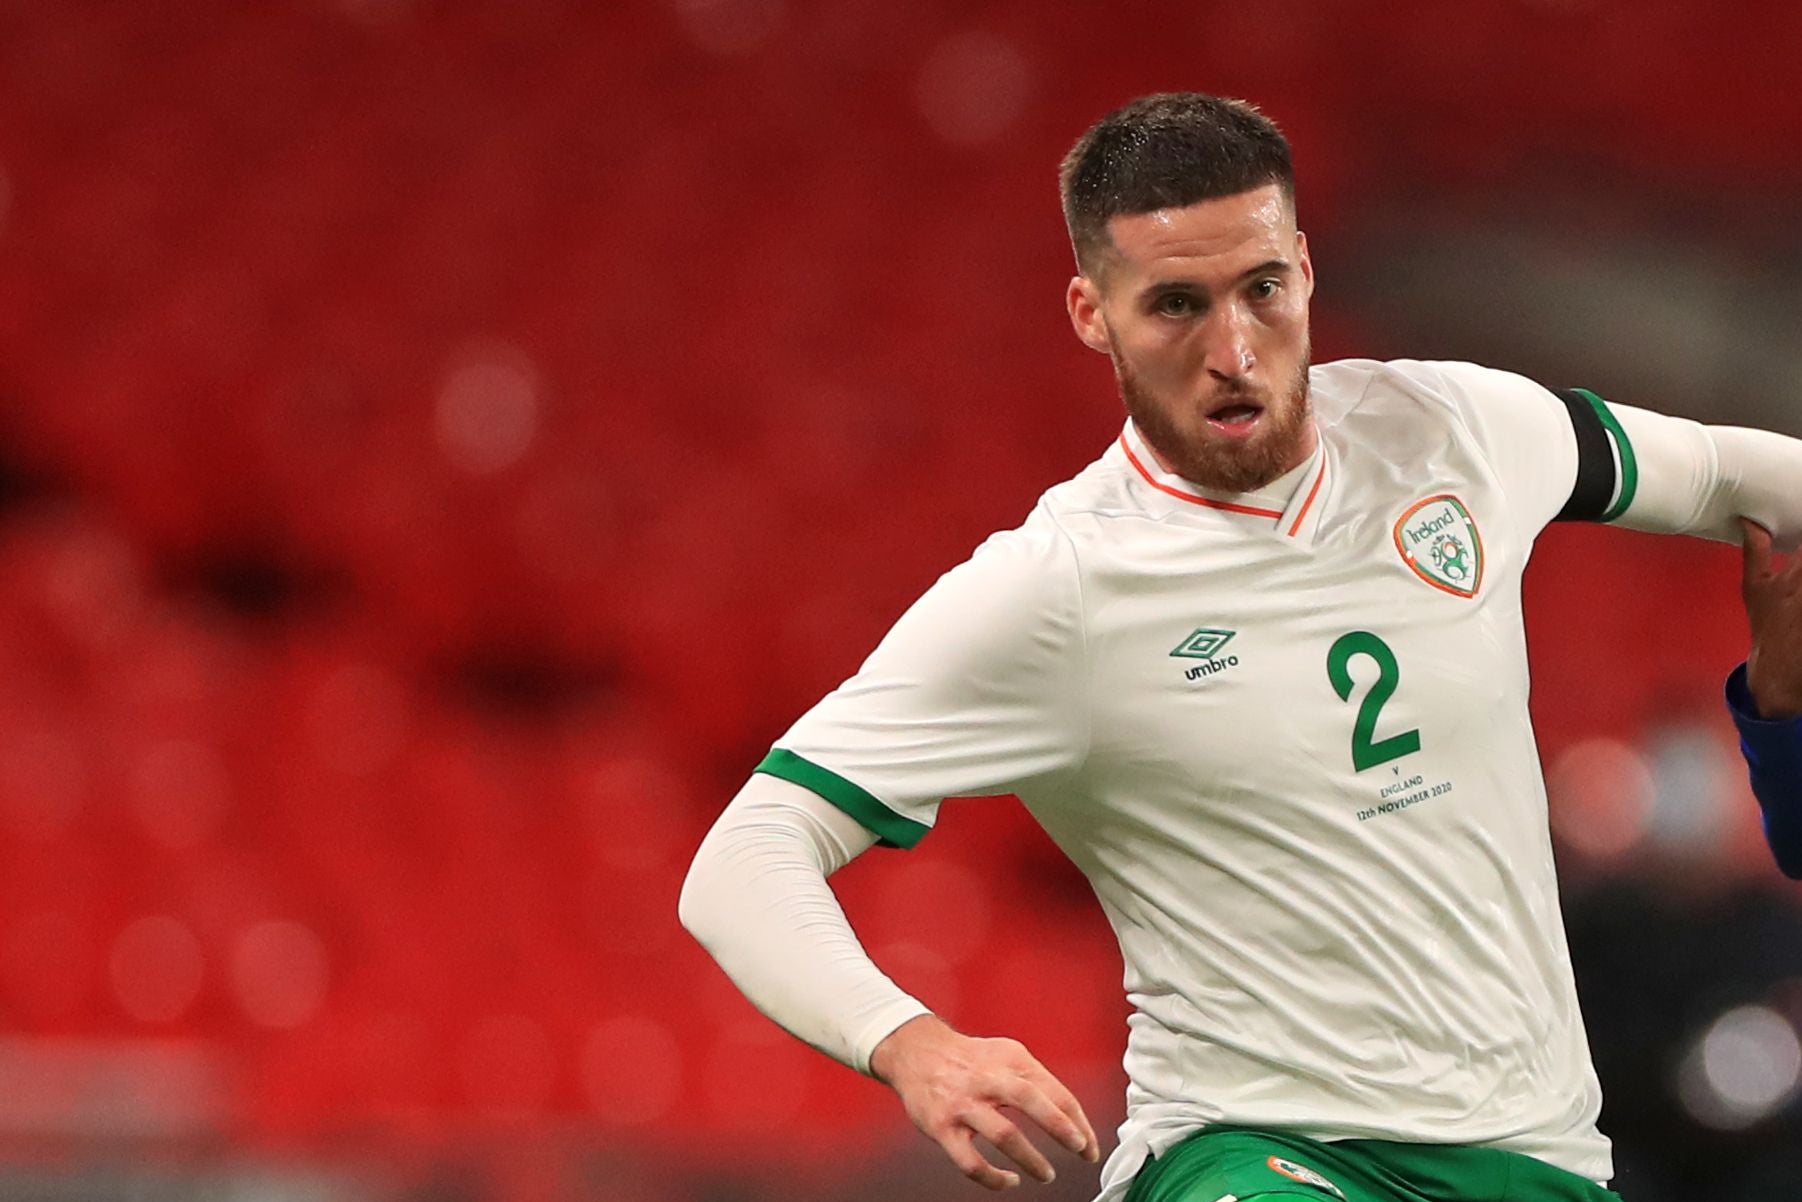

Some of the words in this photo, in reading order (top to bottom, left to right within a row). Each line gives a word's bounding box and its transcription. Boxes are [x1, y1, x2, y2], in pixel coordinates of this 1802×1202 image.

[1406, 508, 1455, 544] Ireland
[1184, 655, 1239, 681] umbro
[1327, 631, 1421, 773] 2
[1356, 807, 1377, 821] 12th
[1377, 790, 1431, 815] NOVEMBER
[1431, 781, 1453, 797] 2020
[1380, 775, 1424, 799] ENGLAND
